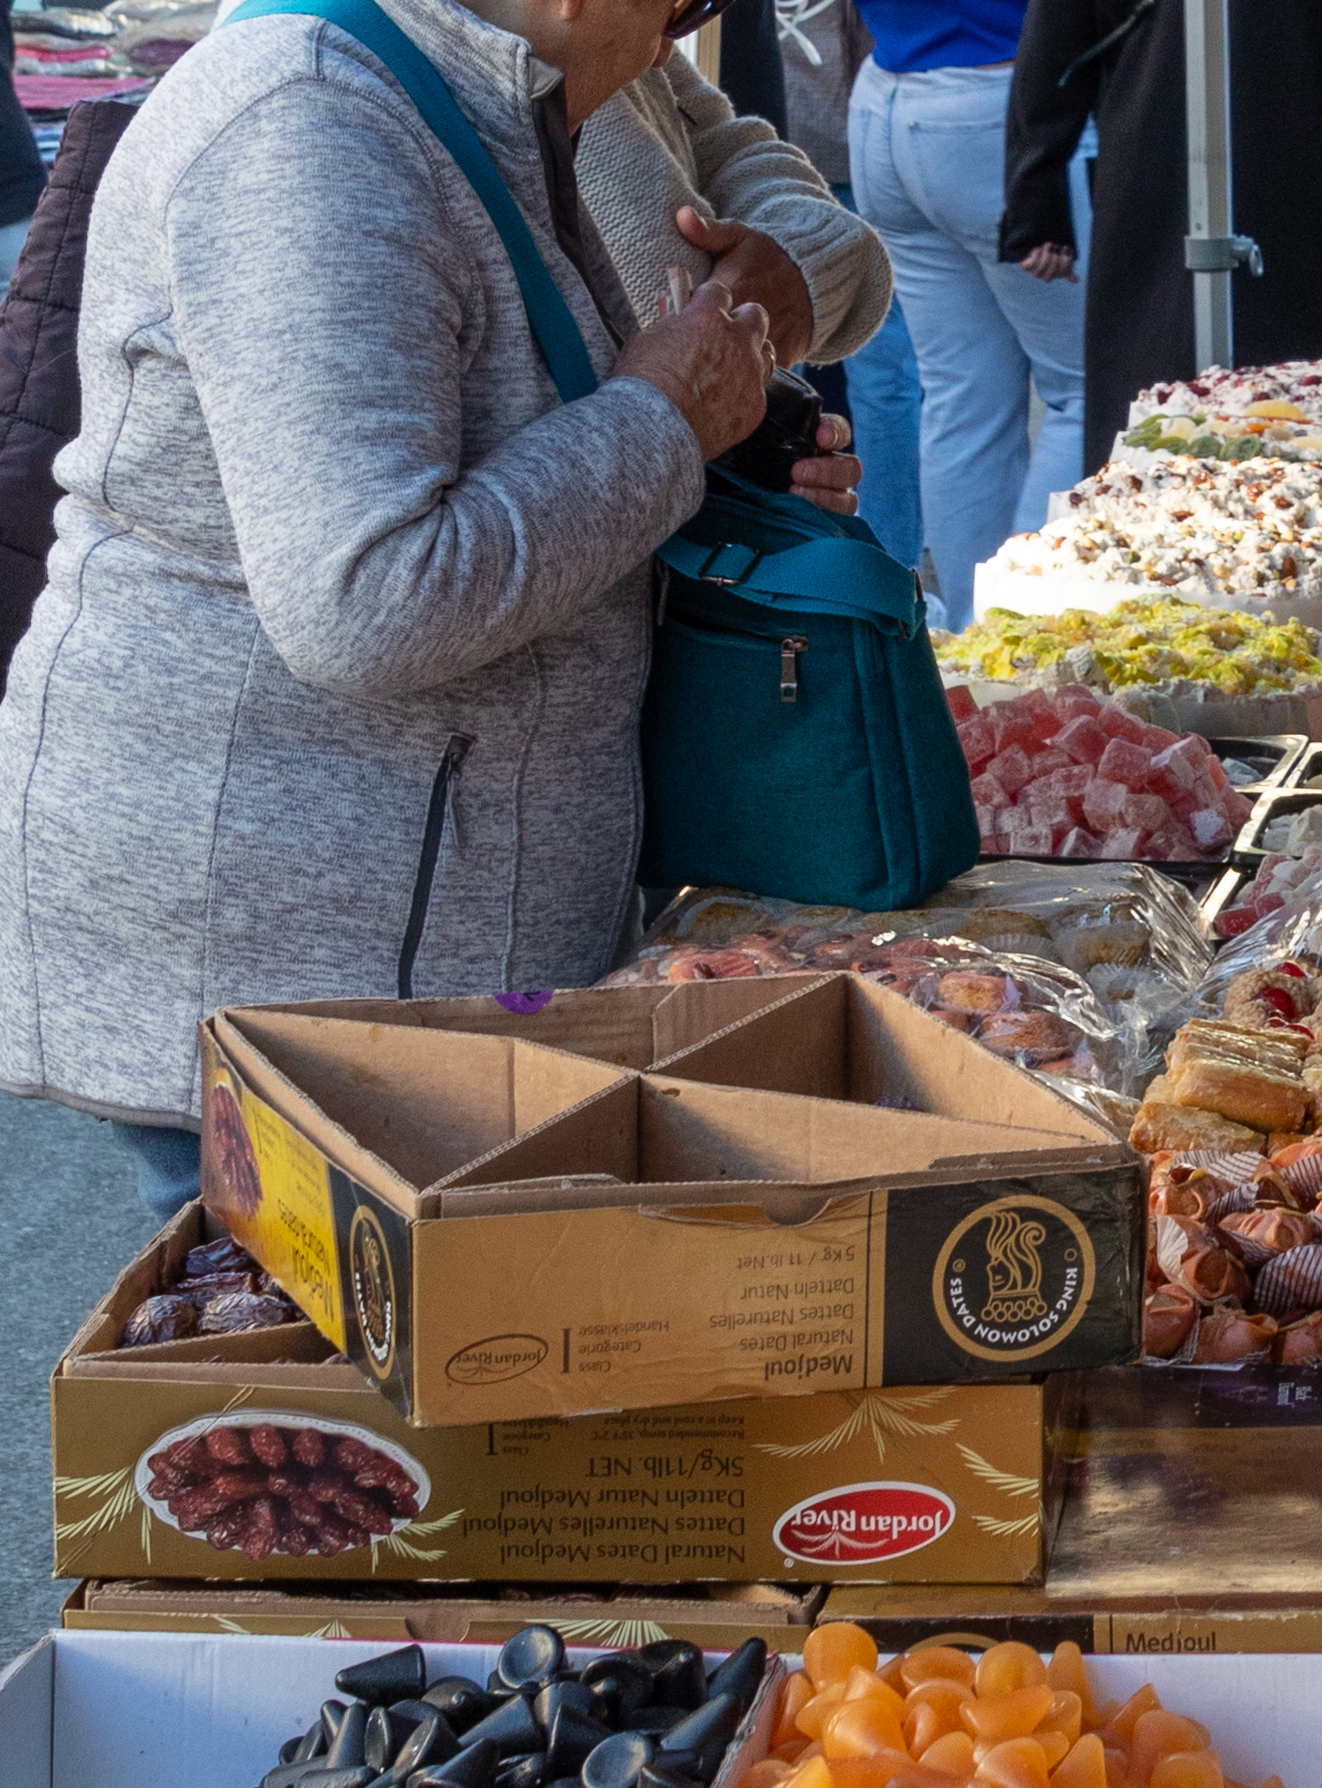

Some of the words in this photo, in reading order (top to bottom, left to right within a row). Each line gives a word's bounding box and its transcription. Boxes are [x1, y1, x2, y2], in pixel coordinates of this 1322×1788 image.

[846, 1245, 856, 1262] 5
[741, 1283, 789, 1301] Natur
[793, 1277, 855, 1298] Datteln
[1056, 1266, 1079, 1312] KING
[799, 1303, 854, 1321] Dattes
[950, 1277, 976, 1327] DATES
[709, 1308, 794, 1331] Naturelles
[974, 1310, 1060, 1344] SOLOMON
[579, 1339, 642, 1355] Categorie
[740, 1335, 787, 1351] Dates
[792, 1329, 853, 1350] Natural
[455, 1351, 493, 1365] River
[493, 1347, 543, 1367] Jordan
[579, 1360, 612, 1373] Class
[764, 1353, 853, 1382] Medjoul
[585, 1456, 632, 1479] NET
[501, 1483, 591, 1510] Medjoul
[596, 1489, 659, 1508] Natur
[666, 1488, 746, 1510] Datteln
[462, 1511, 553, 1538] Medjoul
[559, 1517, 669, 1538] Naturelles
[674, 1517, 746, 1536] Dattes
[790, 1509, 856, 1532] River
[860, 1509, 943, 1540] Jordan
[501, 1538, 591, 1565] Medjoul
[597, 1544, 658, 1564] Dates
[665, 1544, 746, 1565] Natural
[1125, 1631, 1217, 1653] Medjoul
